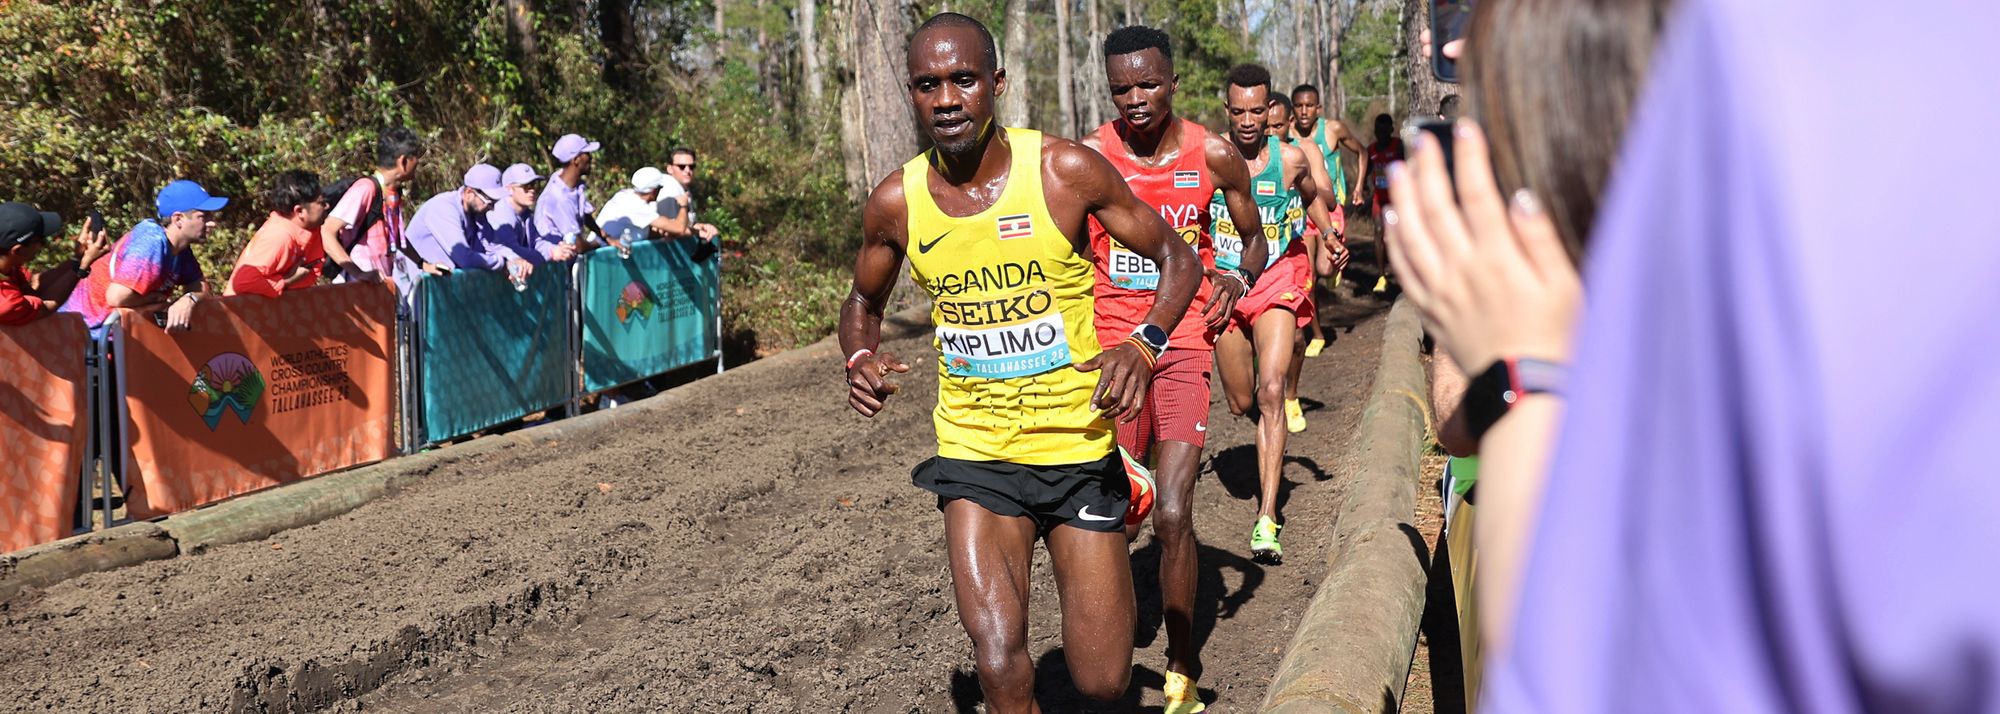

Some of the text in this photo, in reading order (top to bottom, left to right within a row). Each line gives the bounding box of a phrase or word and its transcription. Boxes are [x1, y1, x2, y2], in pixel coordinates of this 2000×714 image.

[939, 290, 1052, 326] SEIKO
[943, 322, 1056, 356] KIPLIMO
[271, 345, 348, 367] WORLD ATHLETICS
[271, 358, 348, 381] CROSS COUNTRY
[975, 347, 1066, 374] TALLAHASSEE 26
[271, 371, 348, 396] CHAMPIONSHIPS
[272, 385, 349, 414] TALLAHASSEE 26
